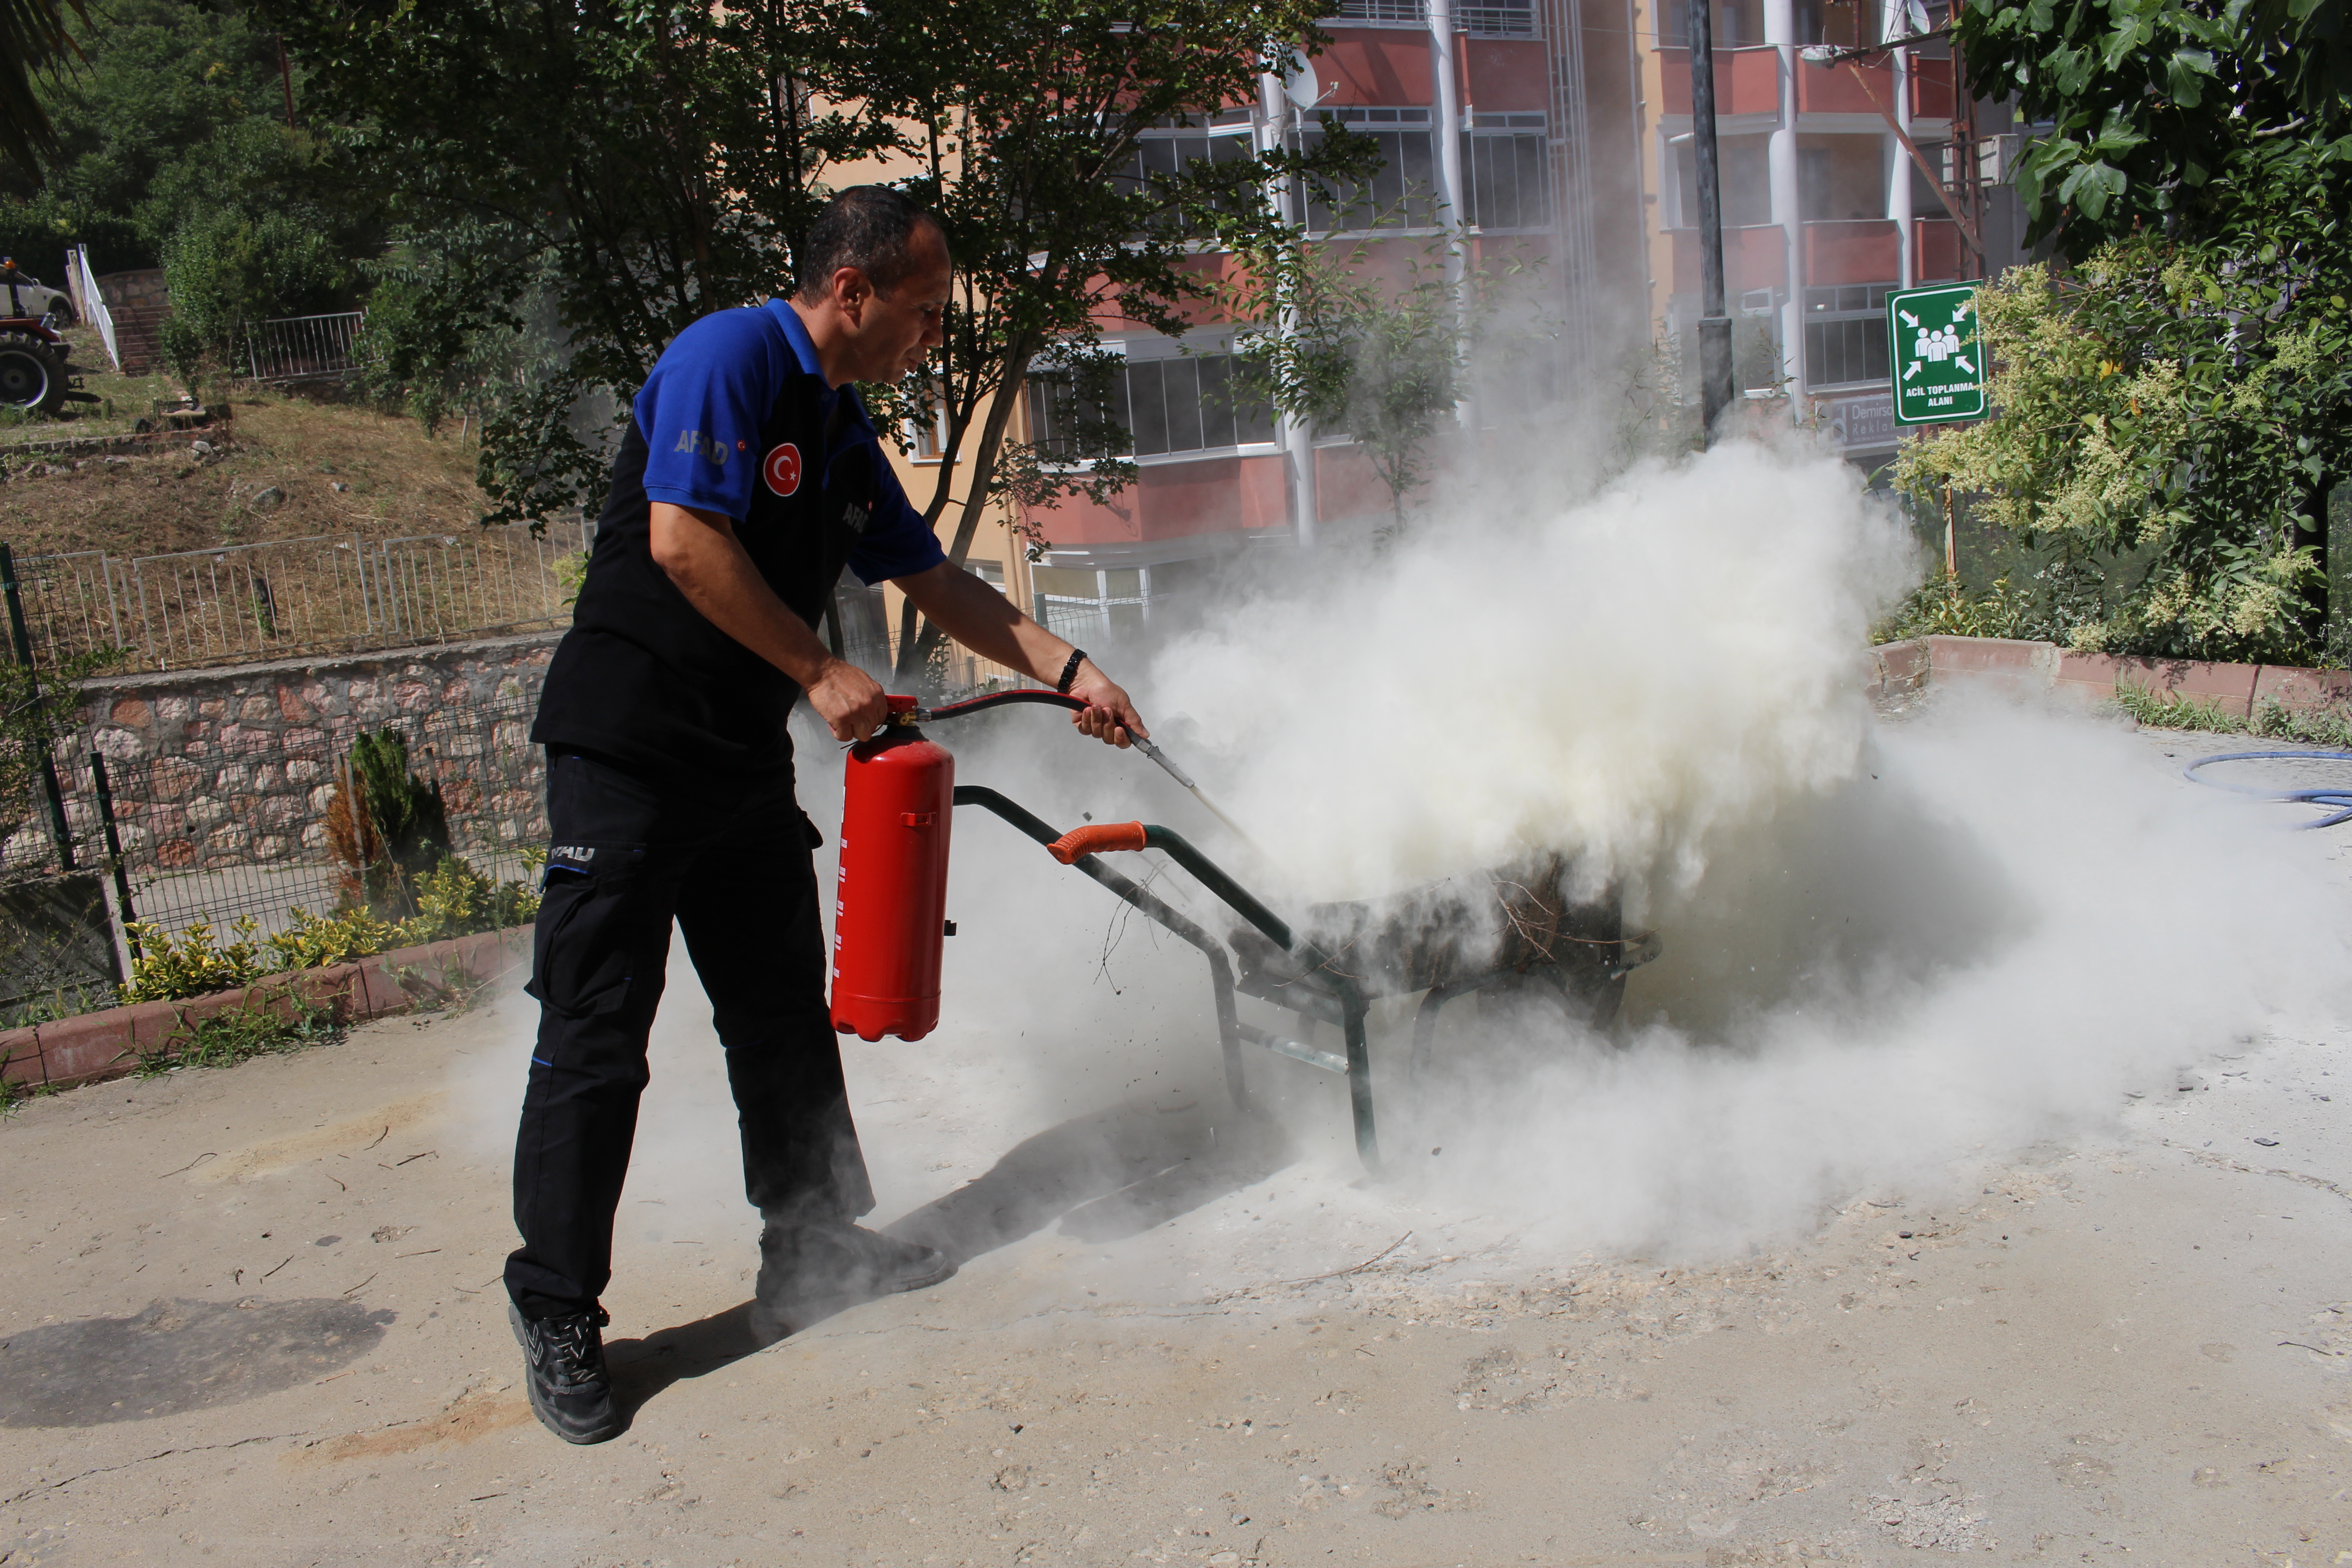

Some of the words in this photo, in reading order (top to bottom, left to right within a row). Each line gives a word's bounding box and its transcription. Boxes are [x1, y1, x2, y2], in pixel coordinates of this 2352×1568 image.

[1906, 385, 1926, 397] ACİL
[1927, 382, 1974, 395] TOPLANMA
[1928, 396, 1953, 407] ALANI
[1852, 402, 1893, 420] Demirso
[674, 430, 728, 465] AFAD
